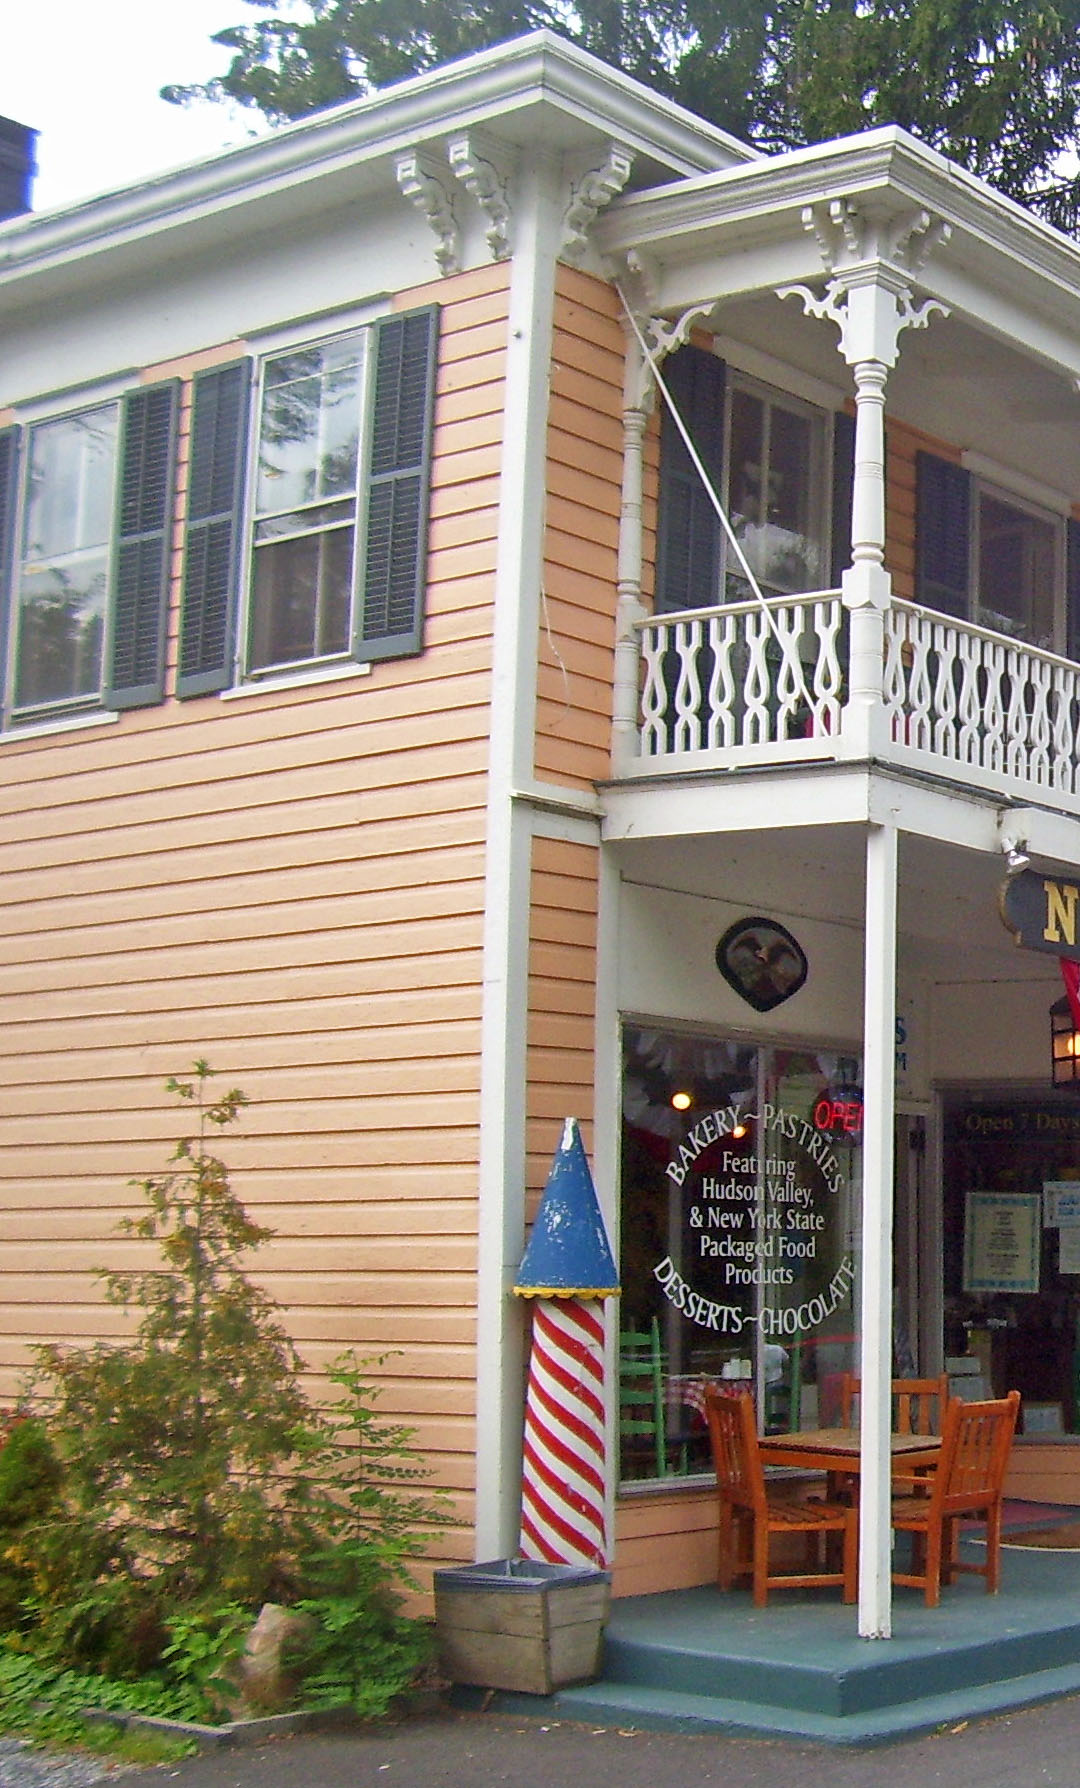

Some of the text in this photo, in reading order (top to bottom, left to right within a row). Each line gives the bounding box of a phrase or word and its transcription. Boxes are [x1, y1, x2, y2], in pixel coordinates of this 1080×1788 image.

[702, 1177, 815, 1209] Hudson Valley,
[690, 1206, 825, 1231] & New York State
[700, 1234, 816, 1263] Packaged Food
[725, 1262, 794, 1285] Products
